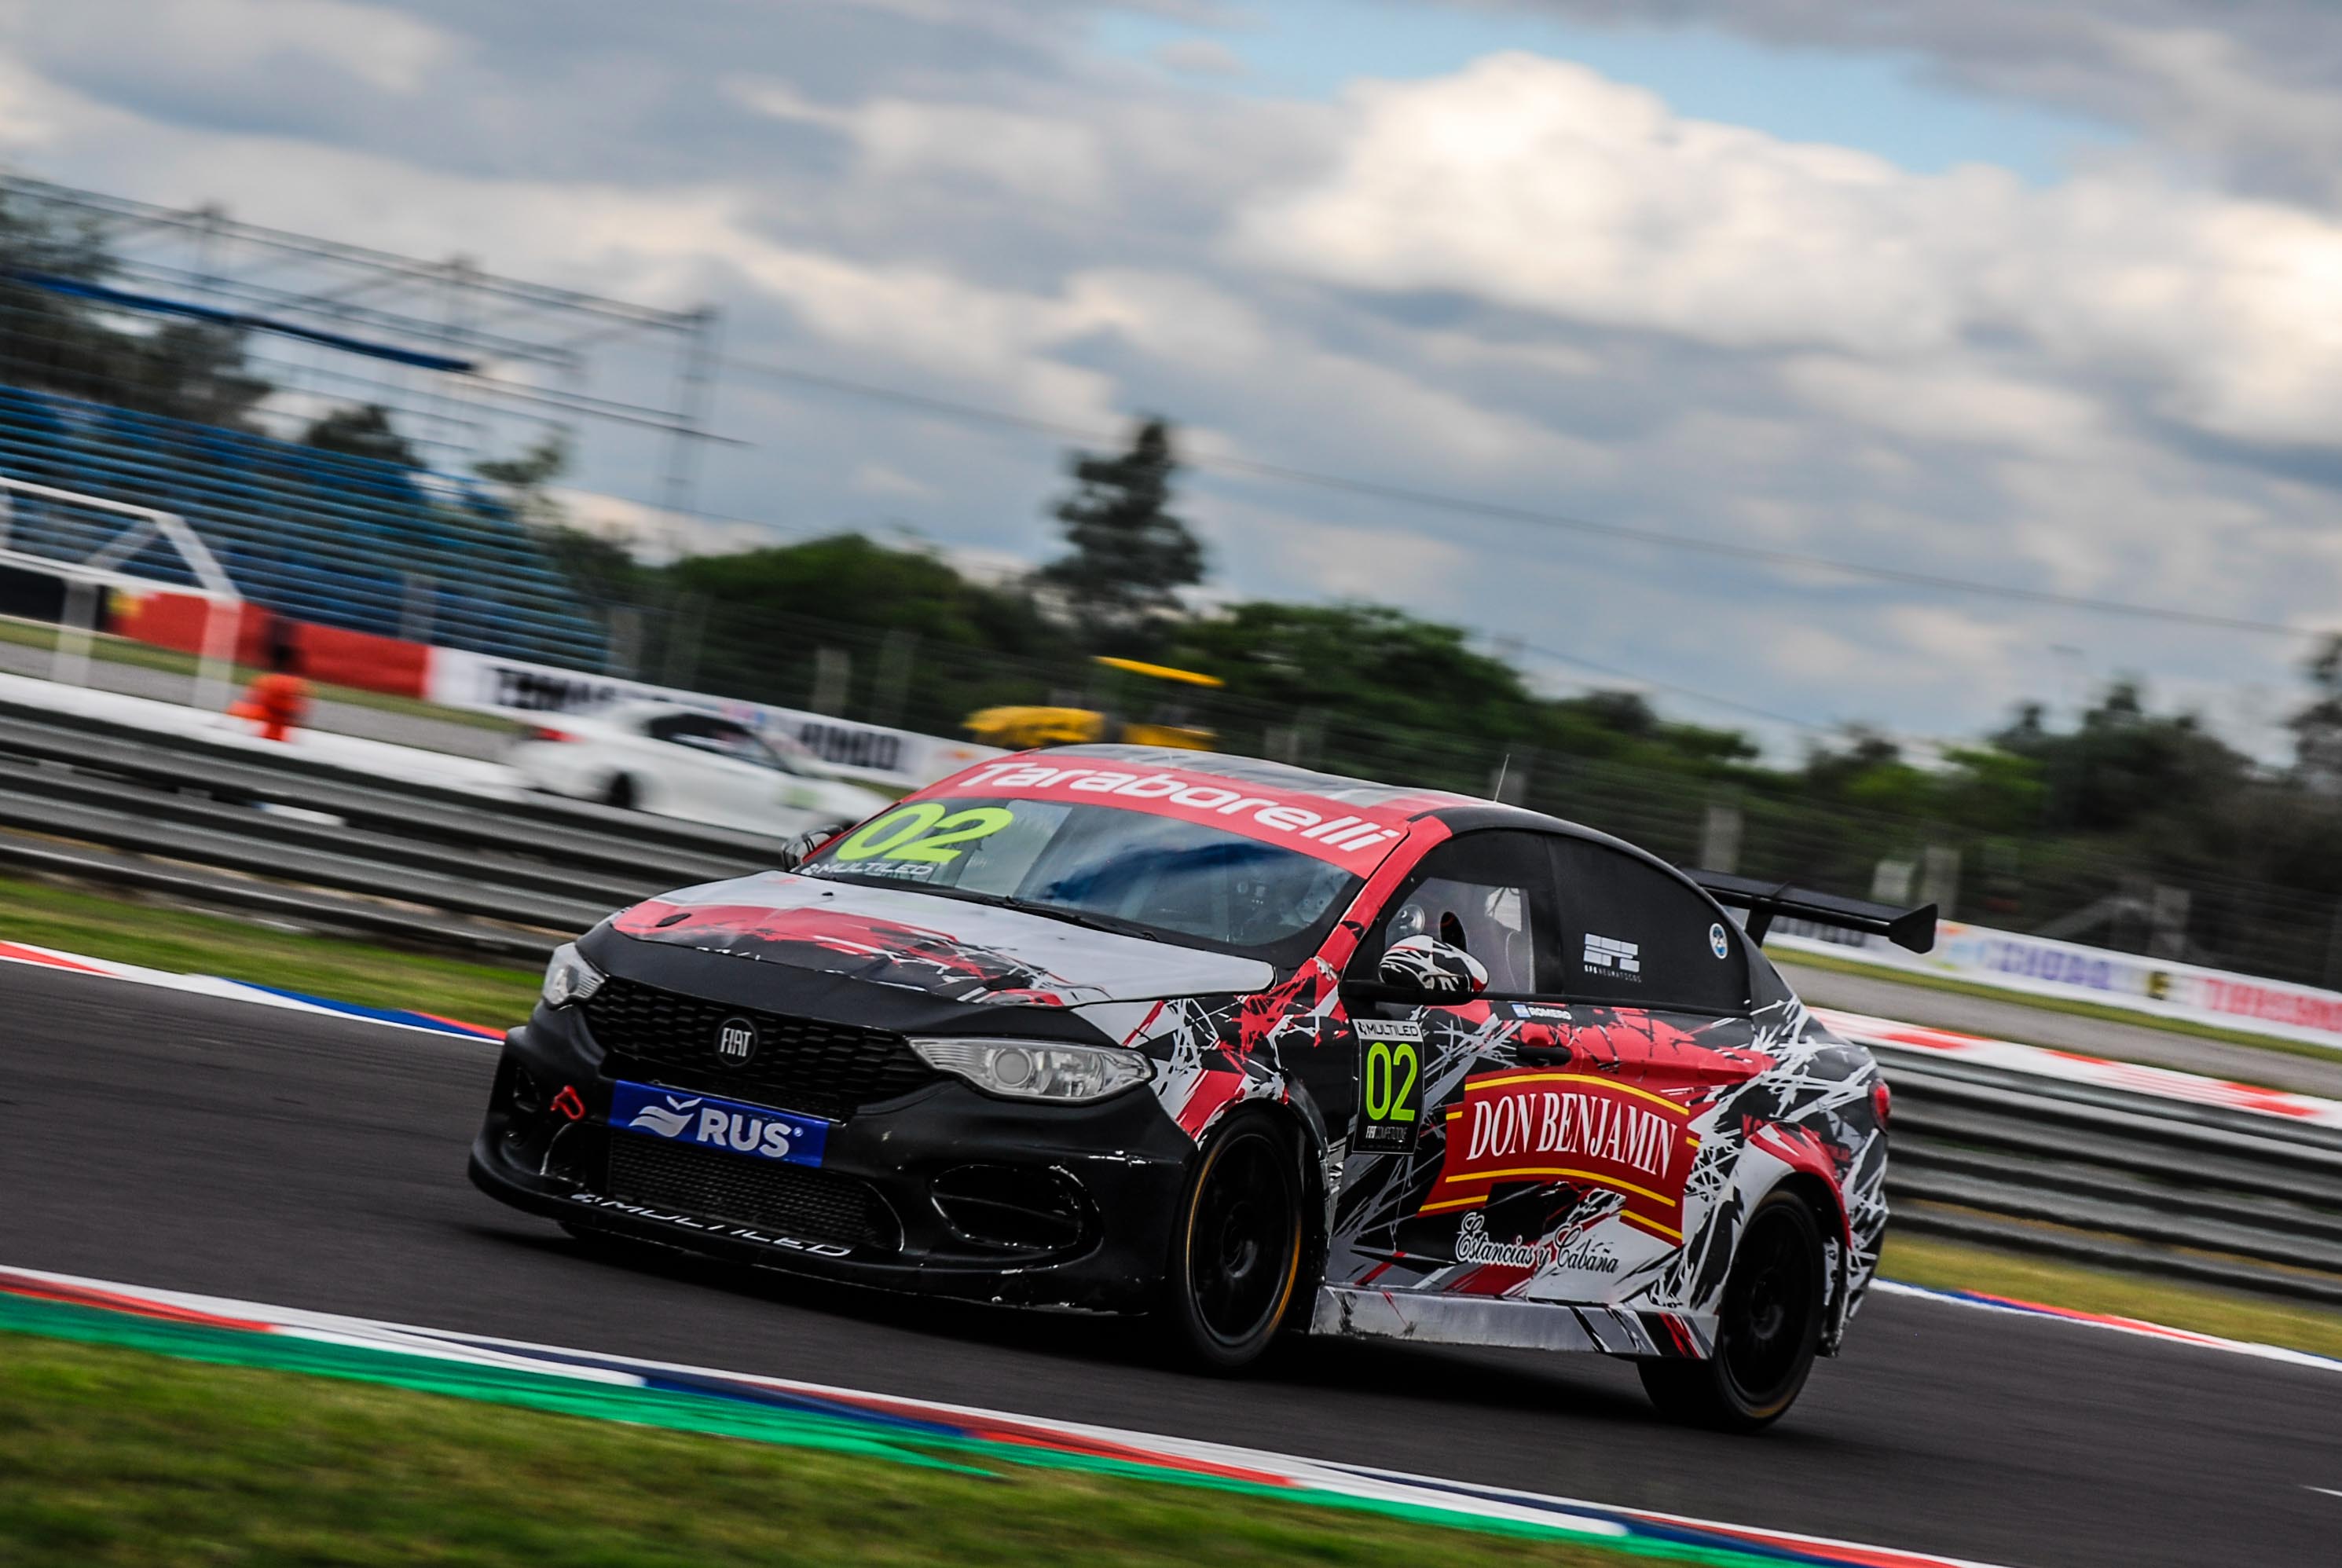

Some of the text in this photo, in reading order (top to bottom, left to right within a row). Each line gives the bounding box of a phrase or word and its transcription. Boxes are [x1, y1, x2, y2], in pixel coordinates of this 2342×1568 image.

[836, 803, 1014, 863] 02
[958, 762, 1402, 852] Taraborelli
[815, 863, 933, 875] MULTILED
[720, 1027, 753, 1057] FIAT
[1365, 1023, 1419, 1037] MULTILED
[1365, 1042, 1418, 1121] 02
[696, 1107, 793, 1158] RUS
[1466, 1092, 1678, 1180] DON BENJAMIN
[1457, 1212, 1535, 1268] Estancias
